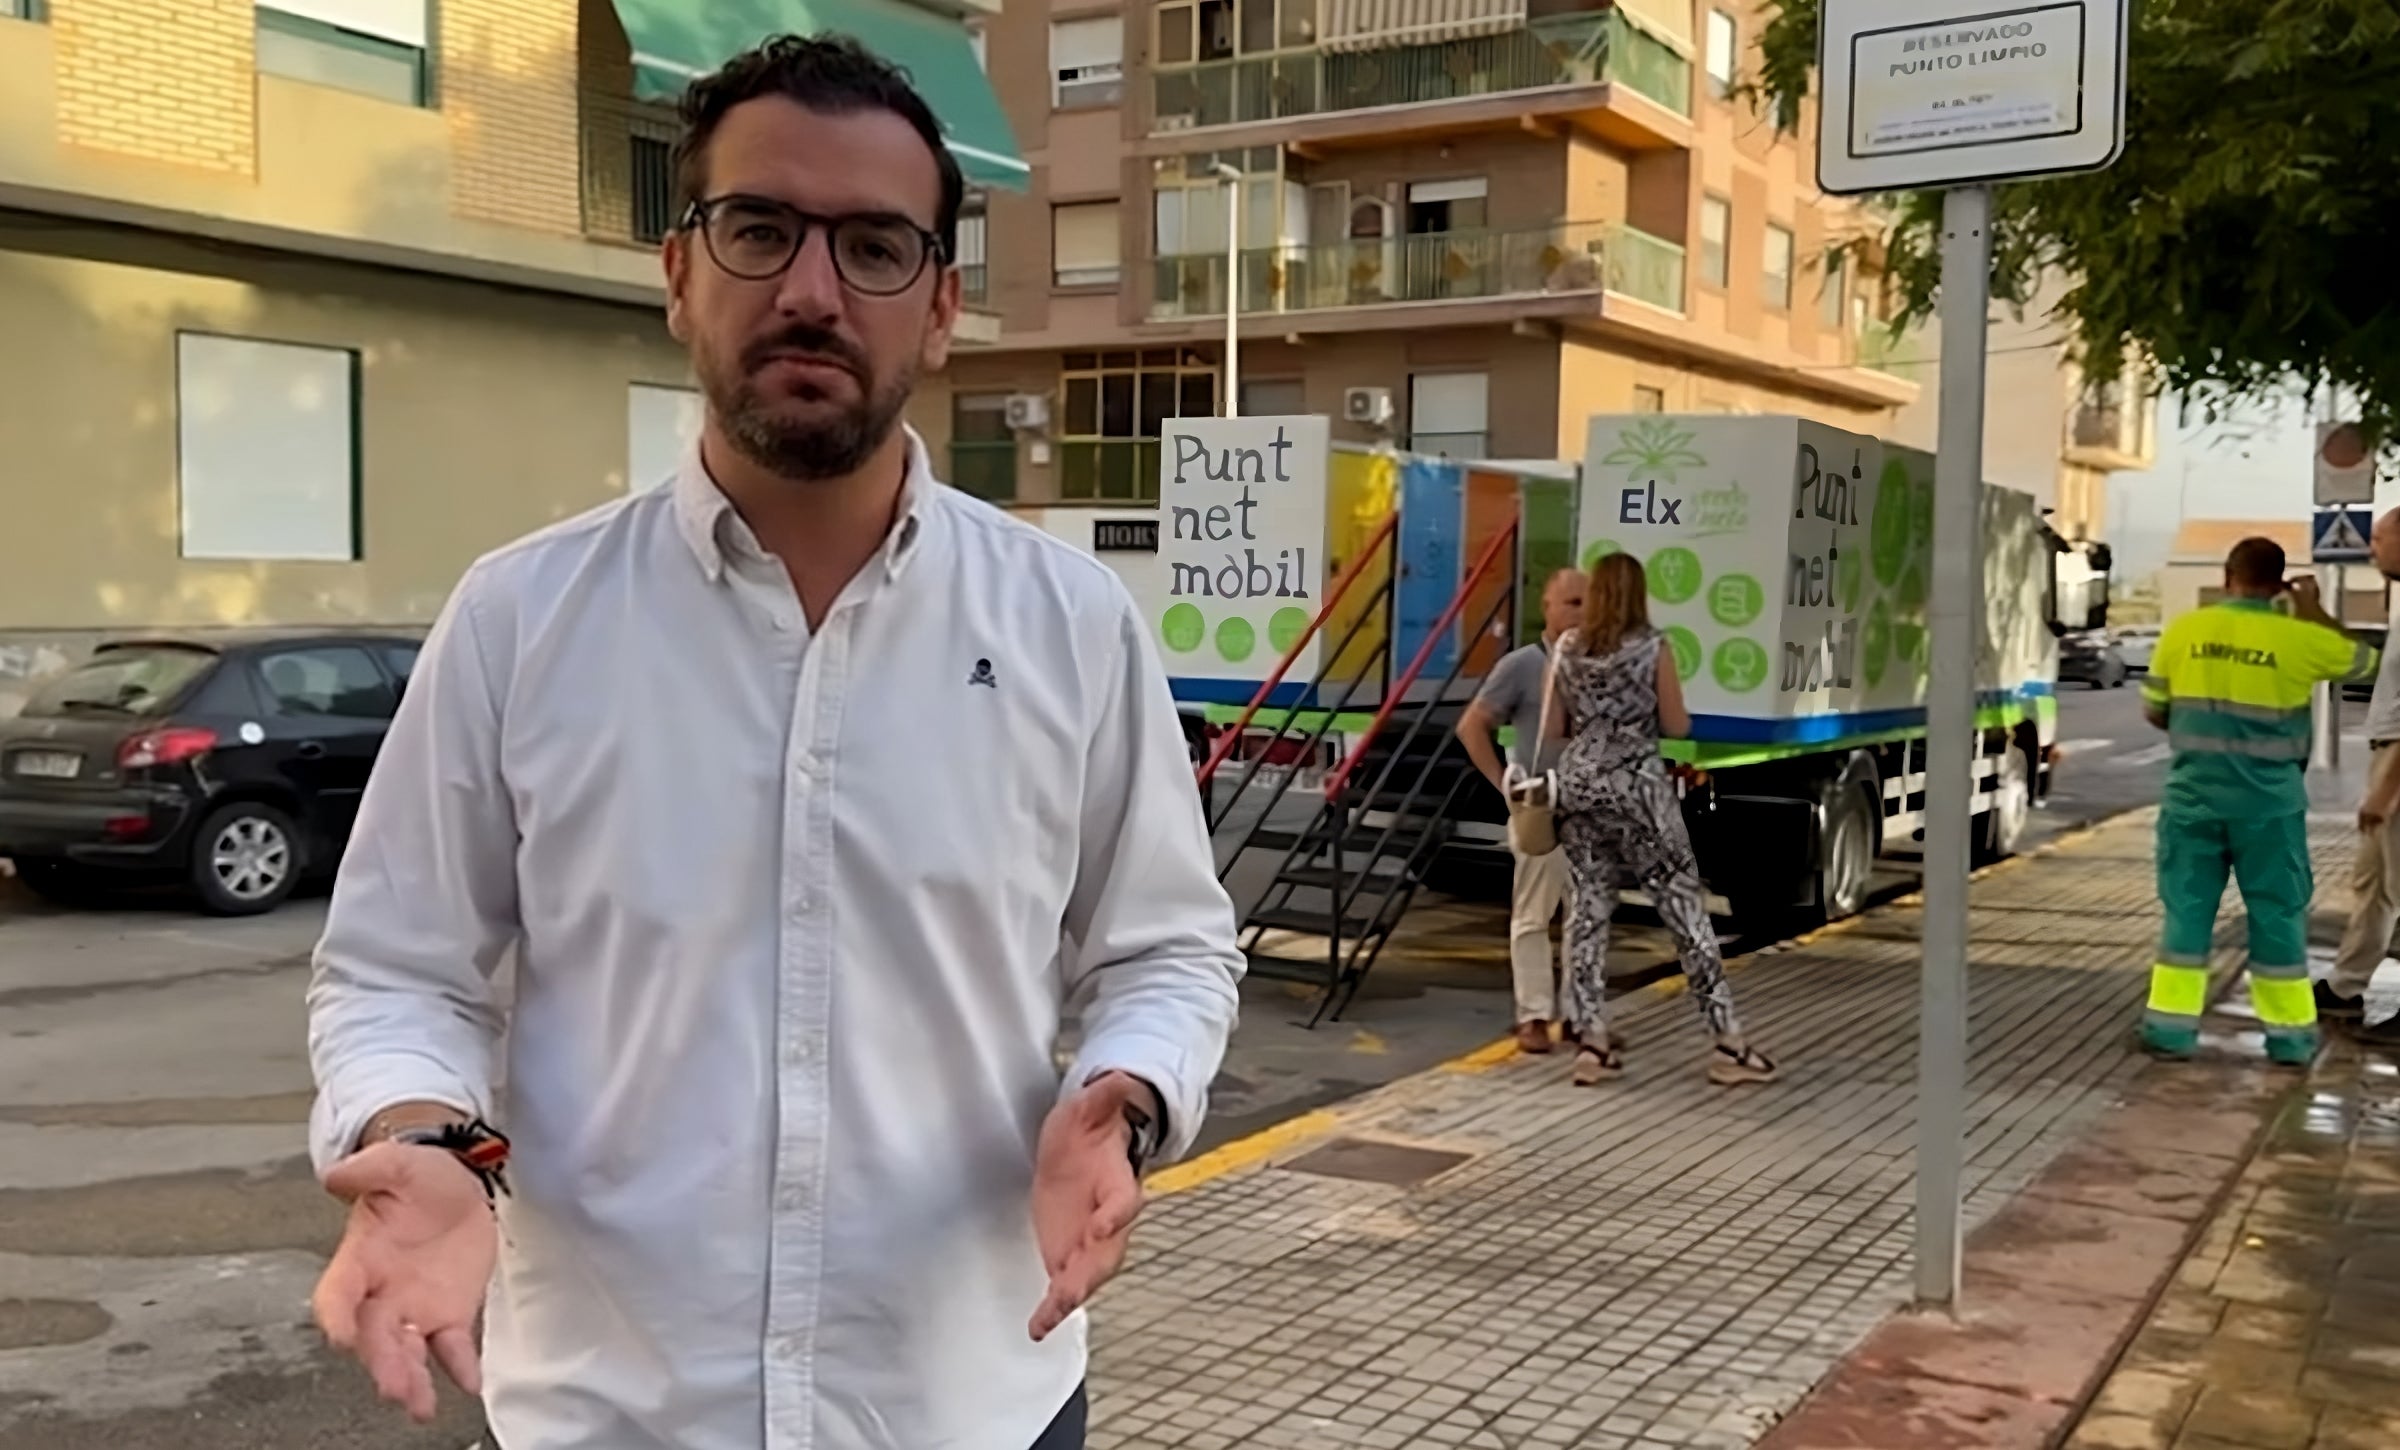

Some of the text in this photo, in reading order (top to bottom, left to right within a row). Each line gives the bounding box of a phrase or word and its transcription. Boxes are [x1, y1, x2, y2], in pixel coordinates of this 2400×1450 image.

[1173, 426, 1293, 484] Punt
[1171, 485, 1258, 541] net
[1619, 479, 1682, 525] Elx
[1170, 547, 1309, 599] mòbil
[2191, 642, 2278, 669] LIMPIEZA
